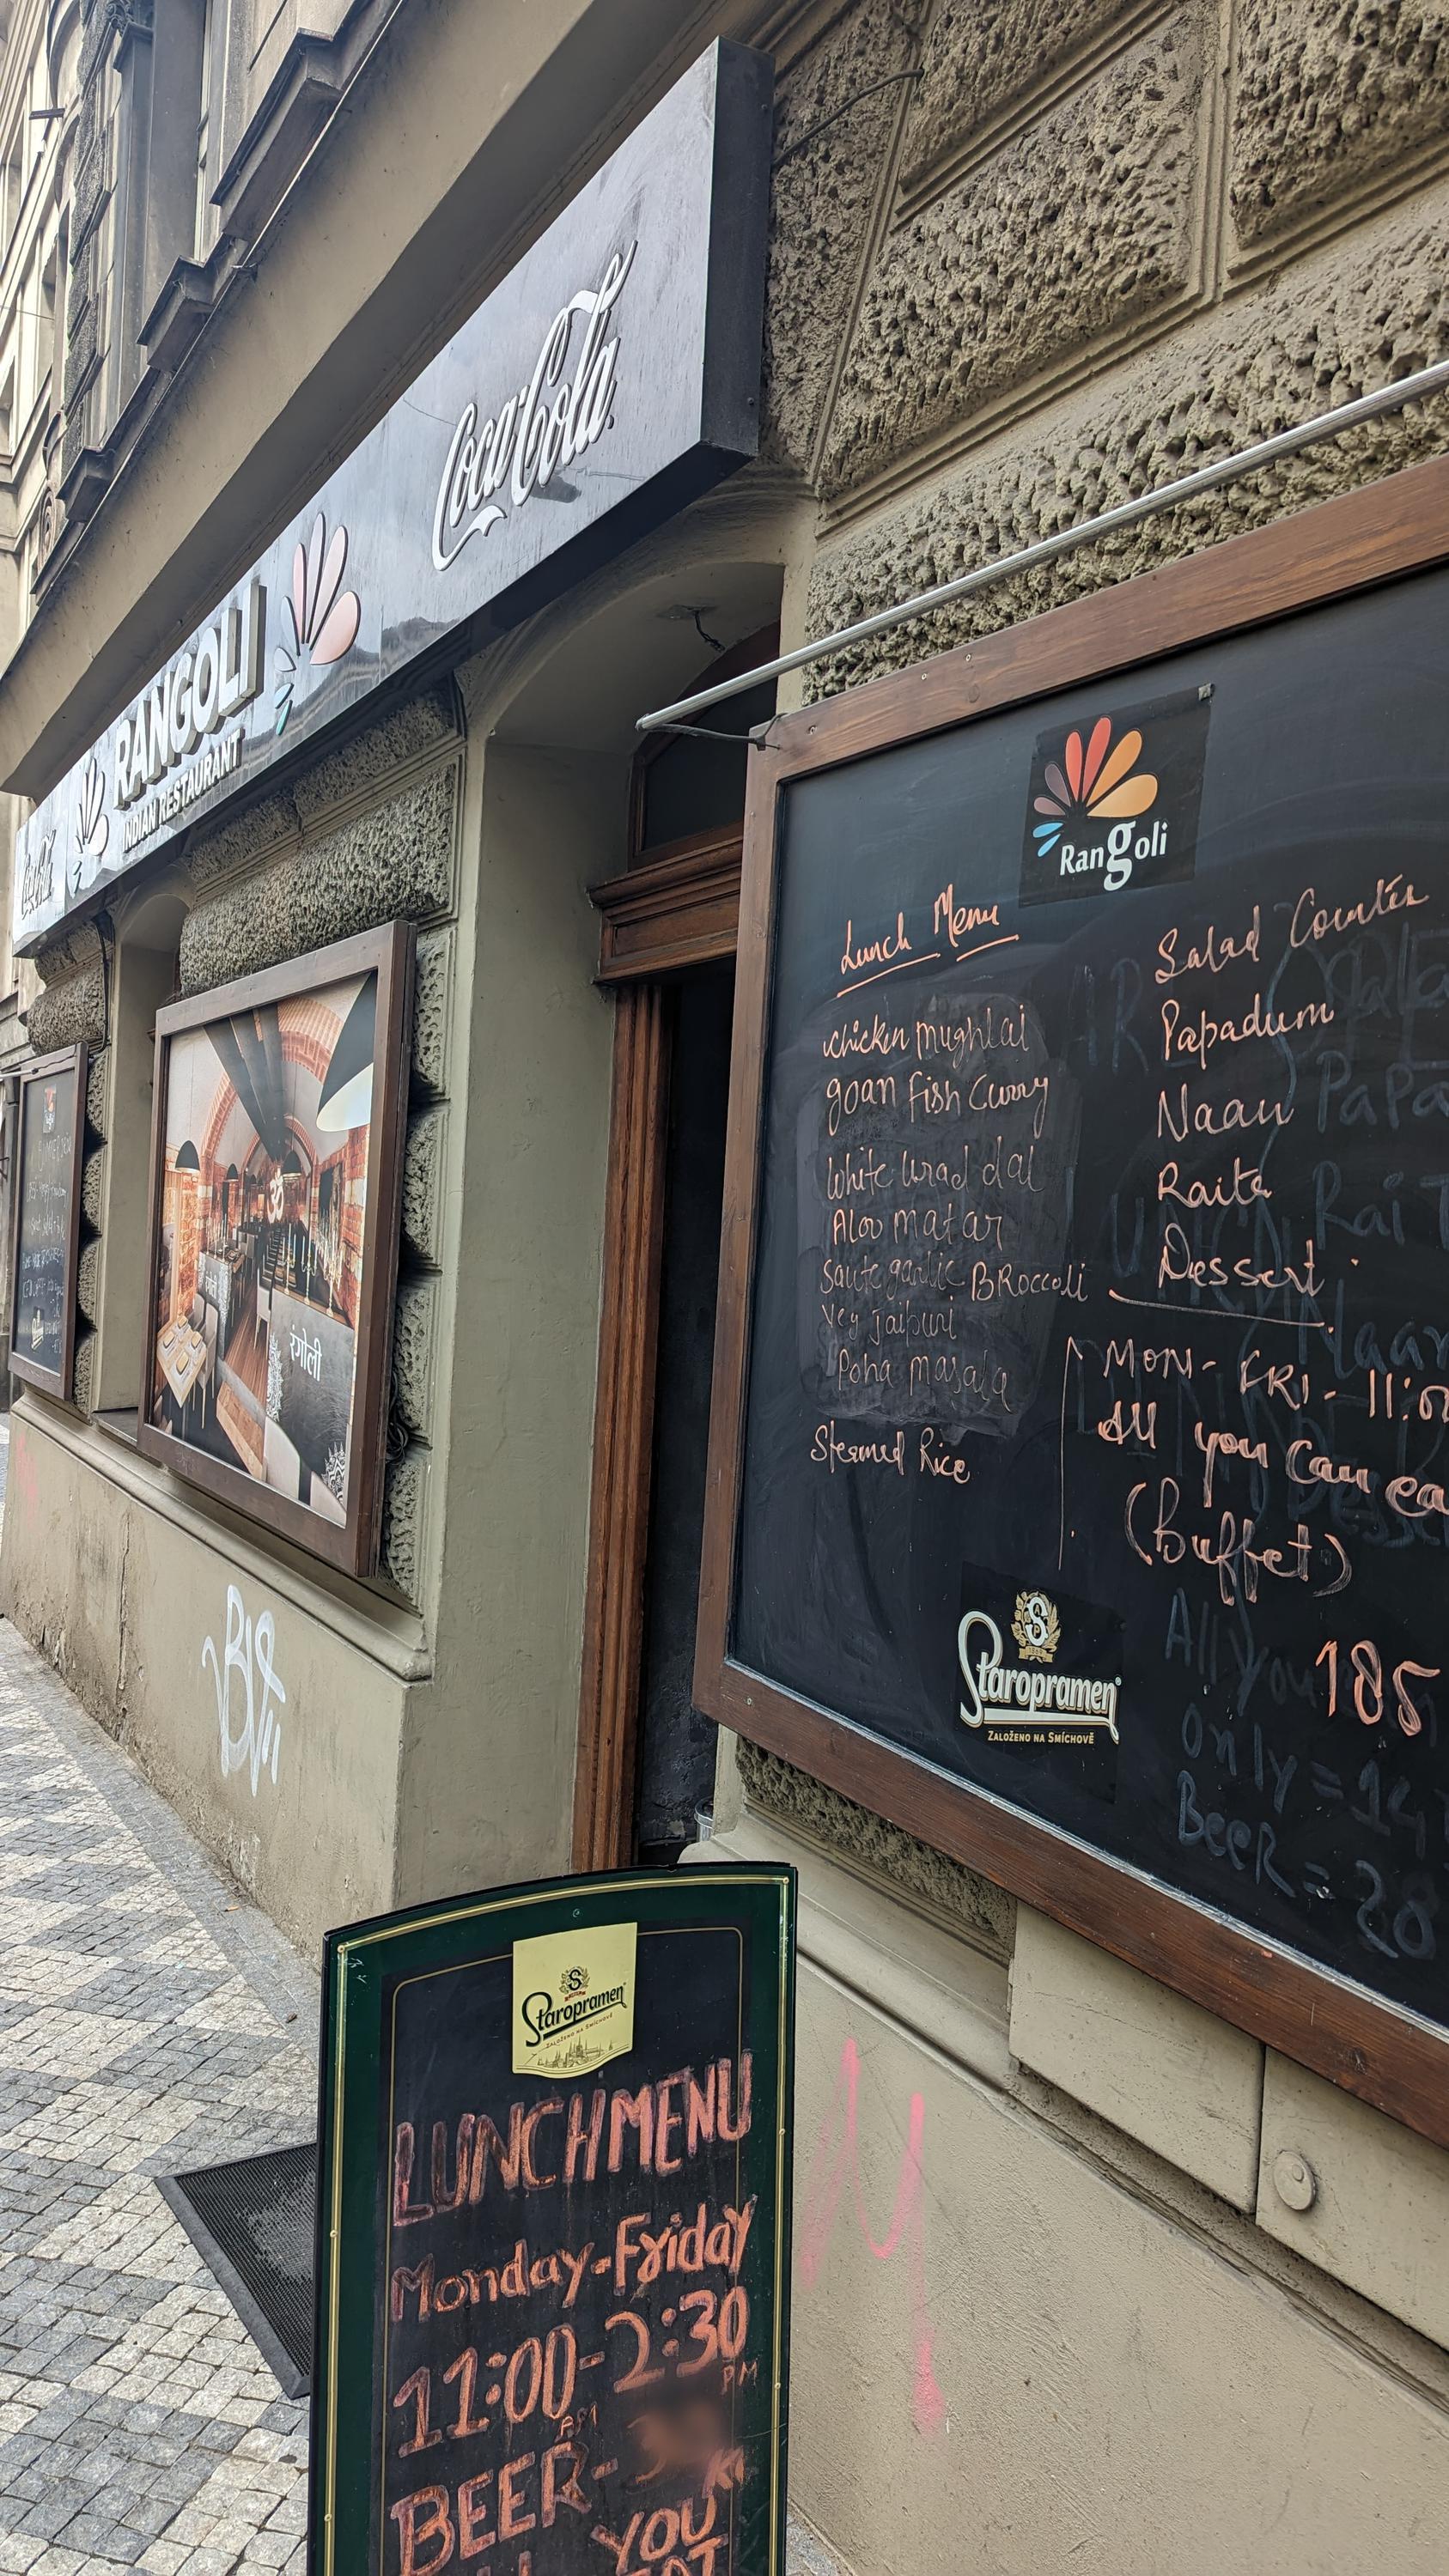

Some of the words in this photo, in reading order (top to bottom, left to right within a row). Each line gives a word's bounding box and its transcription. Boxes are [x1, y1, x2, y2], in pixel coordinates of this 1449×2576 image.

[113, 582, 264, 811] RANGOLI
[123, 797, 161, 853] INDIAN
[158, 728, 245, 823] RESTAURANT
[1060, 821, 1168, 891] Rangoli
[840, 912, 912, 974] Lunch
[935, 883, 1000, 948] Menu
[1154, 905, 1260, 984] Salad
[1161, 993, 1335, 1070] Papadum
[1158, 1083, 1294, 1142] Naan
[289, 1323, 323, 1382] रंगोली
[919, 1427, 971, 1485] Rice
[1195, 1421, 1269, 1509] you
[958, 1611, 1120, 1745] Staropramen
[1316, 1639, 1442, 1737] 185
[521, 1984, 628, 2048] Staropramen
